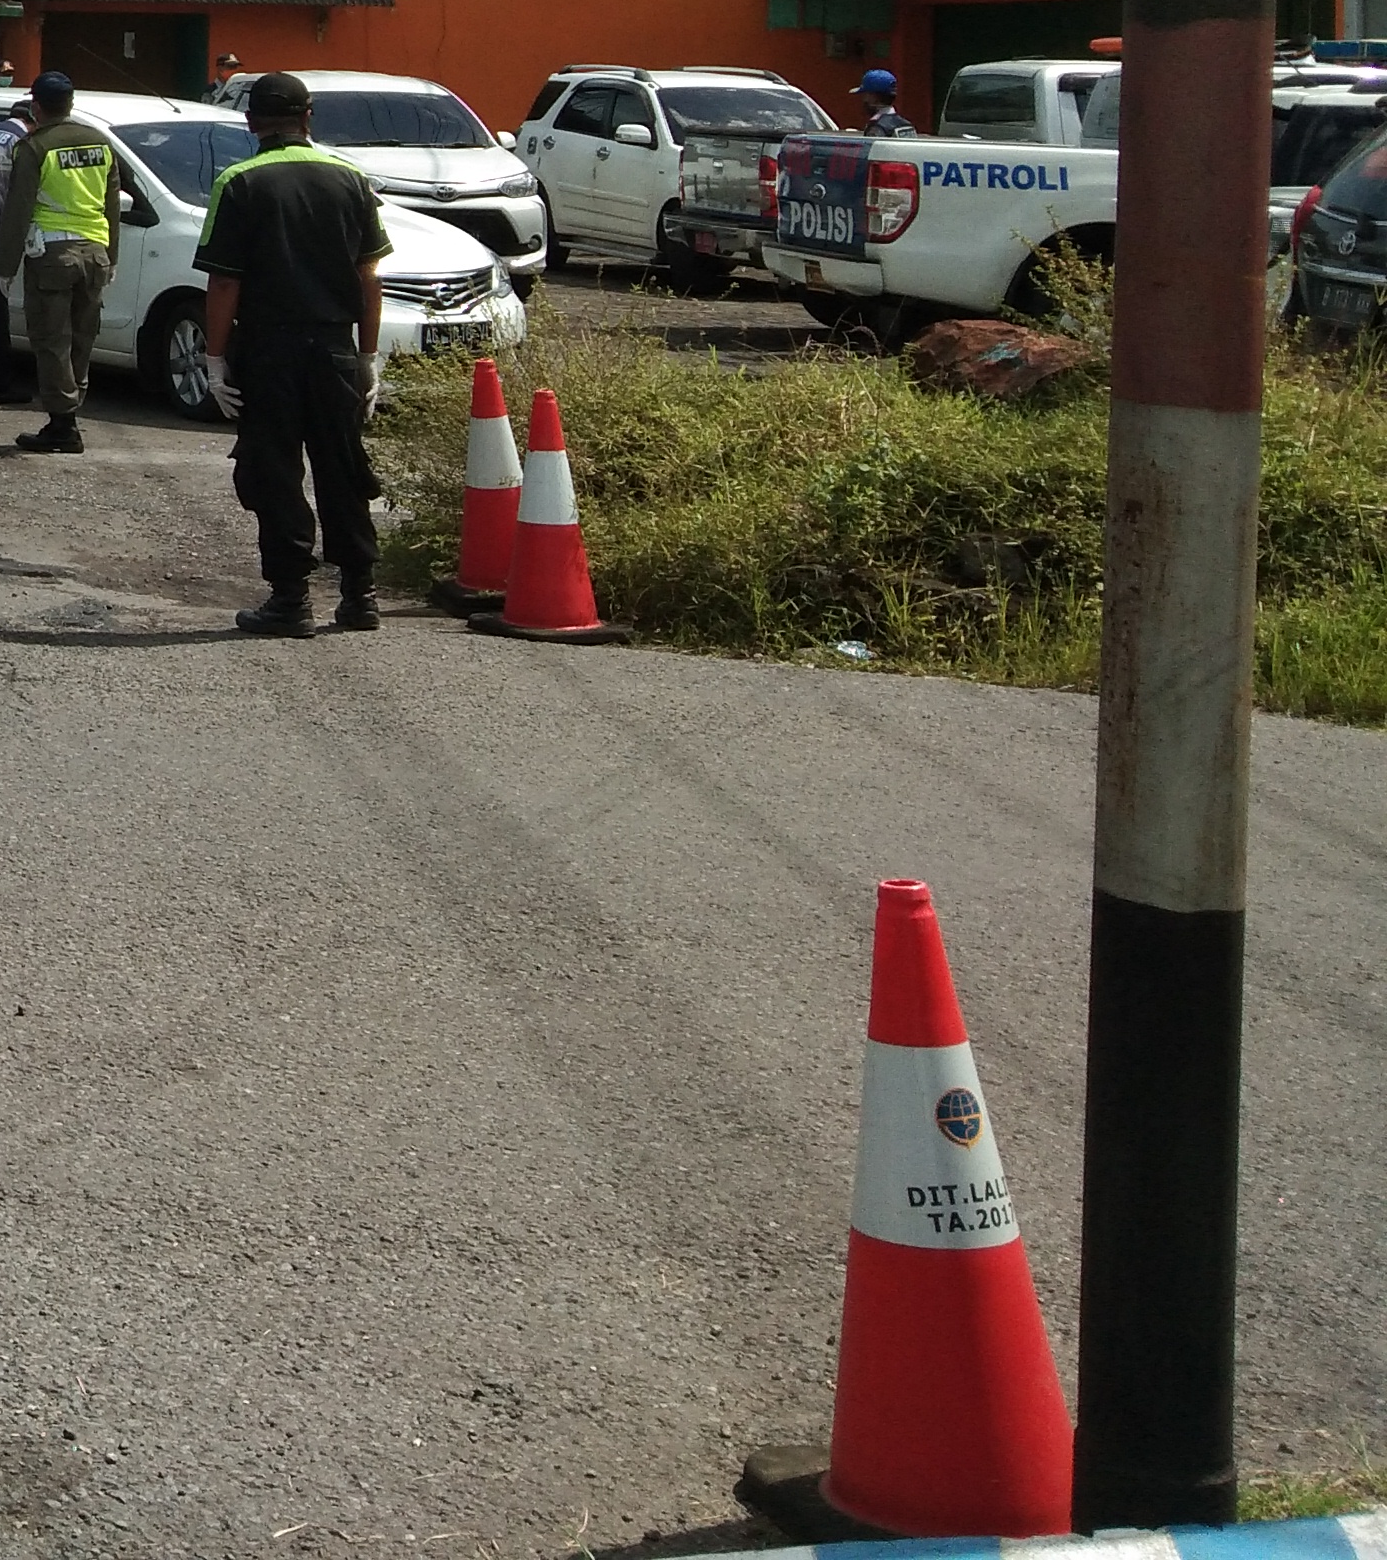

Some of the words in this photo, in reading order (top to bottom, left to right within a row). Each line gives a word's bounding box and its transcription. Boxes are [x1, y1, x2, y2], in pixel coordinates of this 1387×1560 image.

[59, 148, 104, 167] POL-PP
[922, 161, 1069, 191] PATROLI
[789, 200, 854, 245] POLISI
